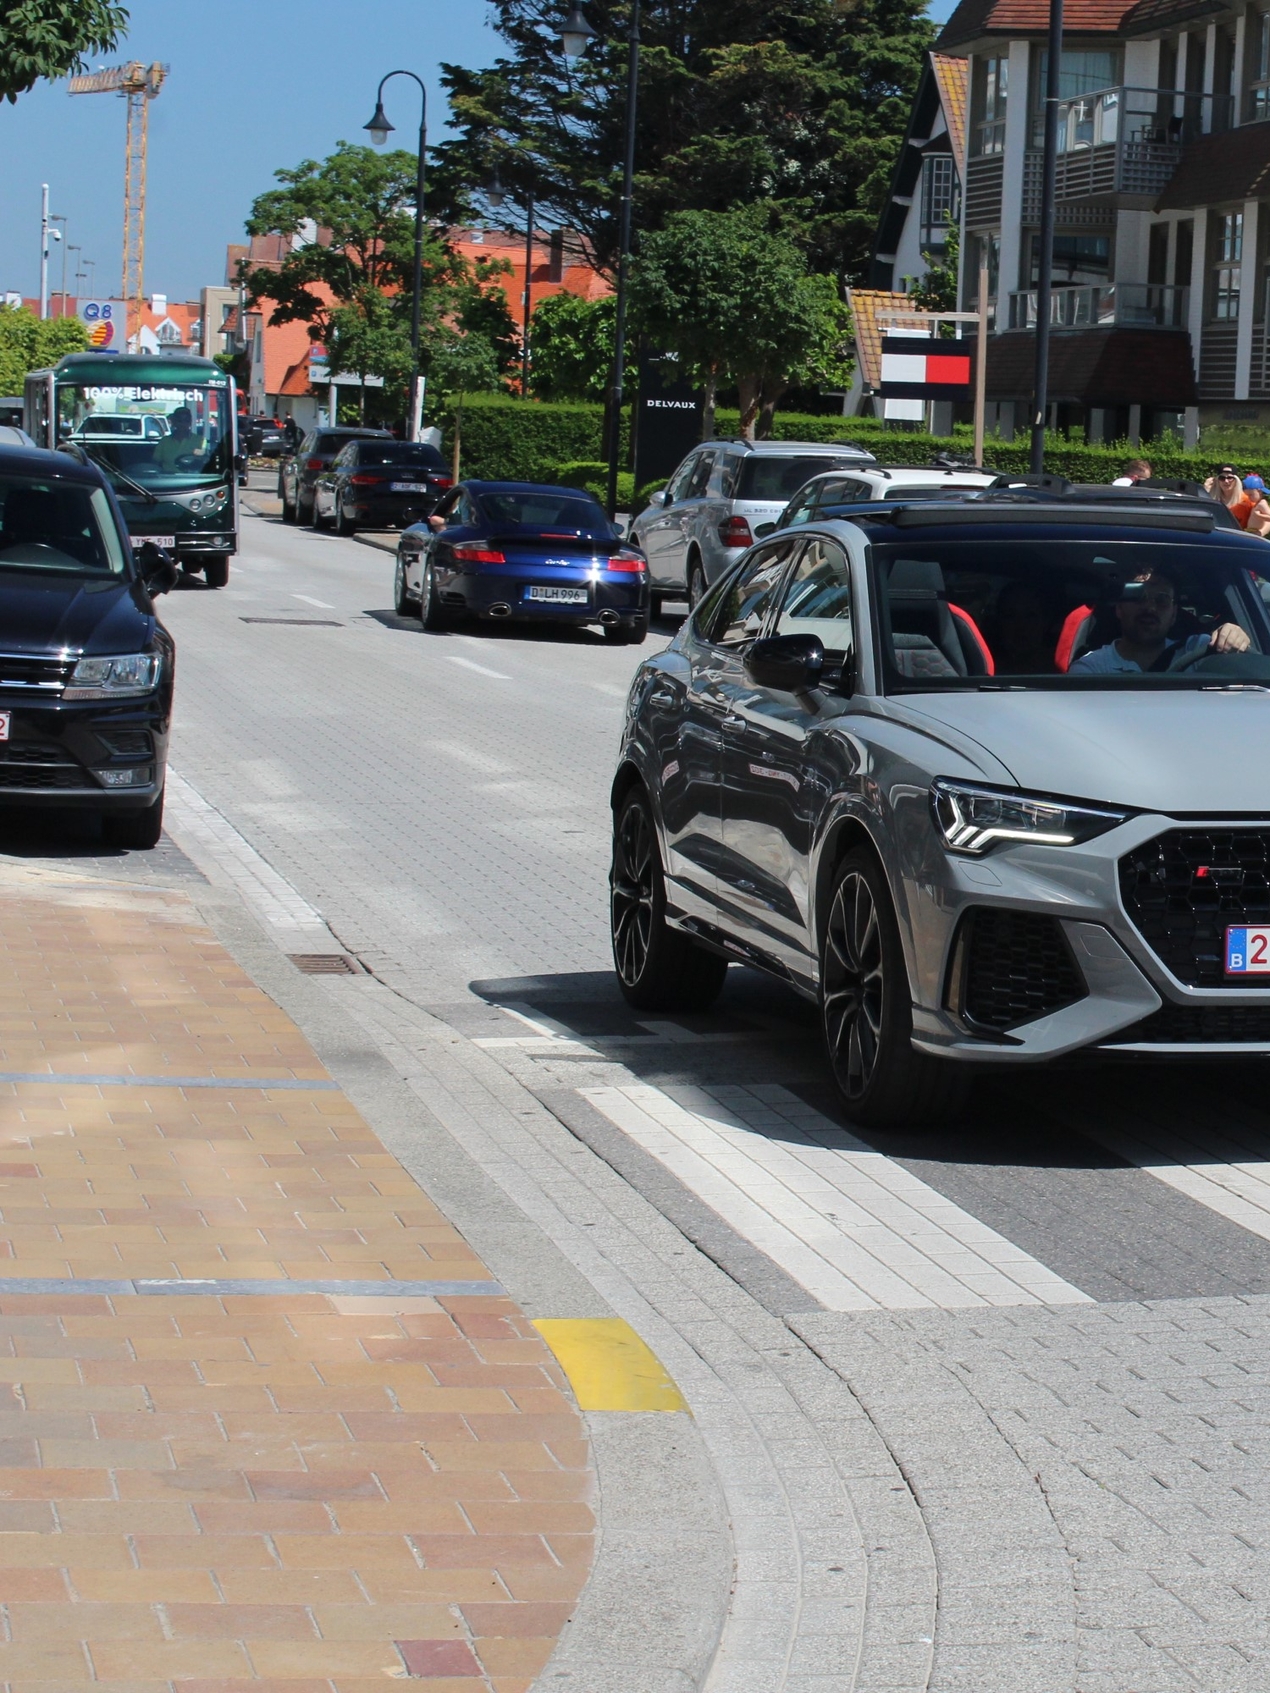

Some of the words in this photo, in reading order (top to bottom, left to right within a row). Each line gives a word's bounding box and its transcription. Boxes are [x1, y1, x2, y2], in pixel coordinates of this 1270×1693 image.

[85, 303, 112, 319] Q8
[83, 386, 124, 400] 100%
[130, 386, 204, 402] Elektrisch
[647, 400, 696, 409] DELVAUX
[1231, 953, 1243, 968] B
